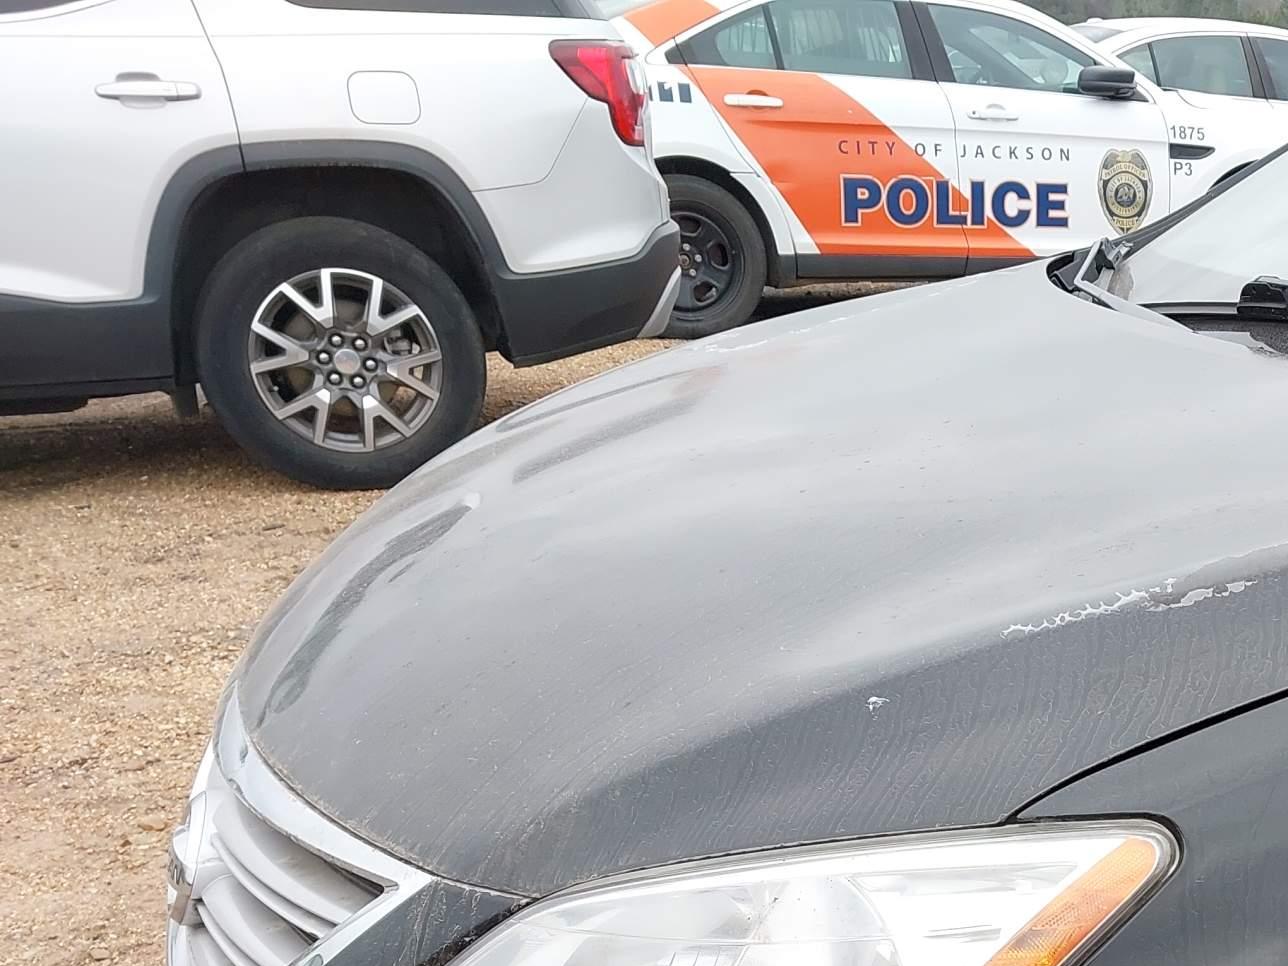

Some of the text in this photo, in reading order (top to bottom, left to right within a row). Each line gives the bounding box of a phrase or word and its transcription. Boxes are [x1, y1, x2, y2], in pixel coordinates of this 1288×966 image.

[1170, 125, 1205, 141] 1875
[838, 139, 1071, 162] CITY OF JACKSON
[1173, 161, 1193, 176] P3
[840, 173, 1070, 229] POLICE
